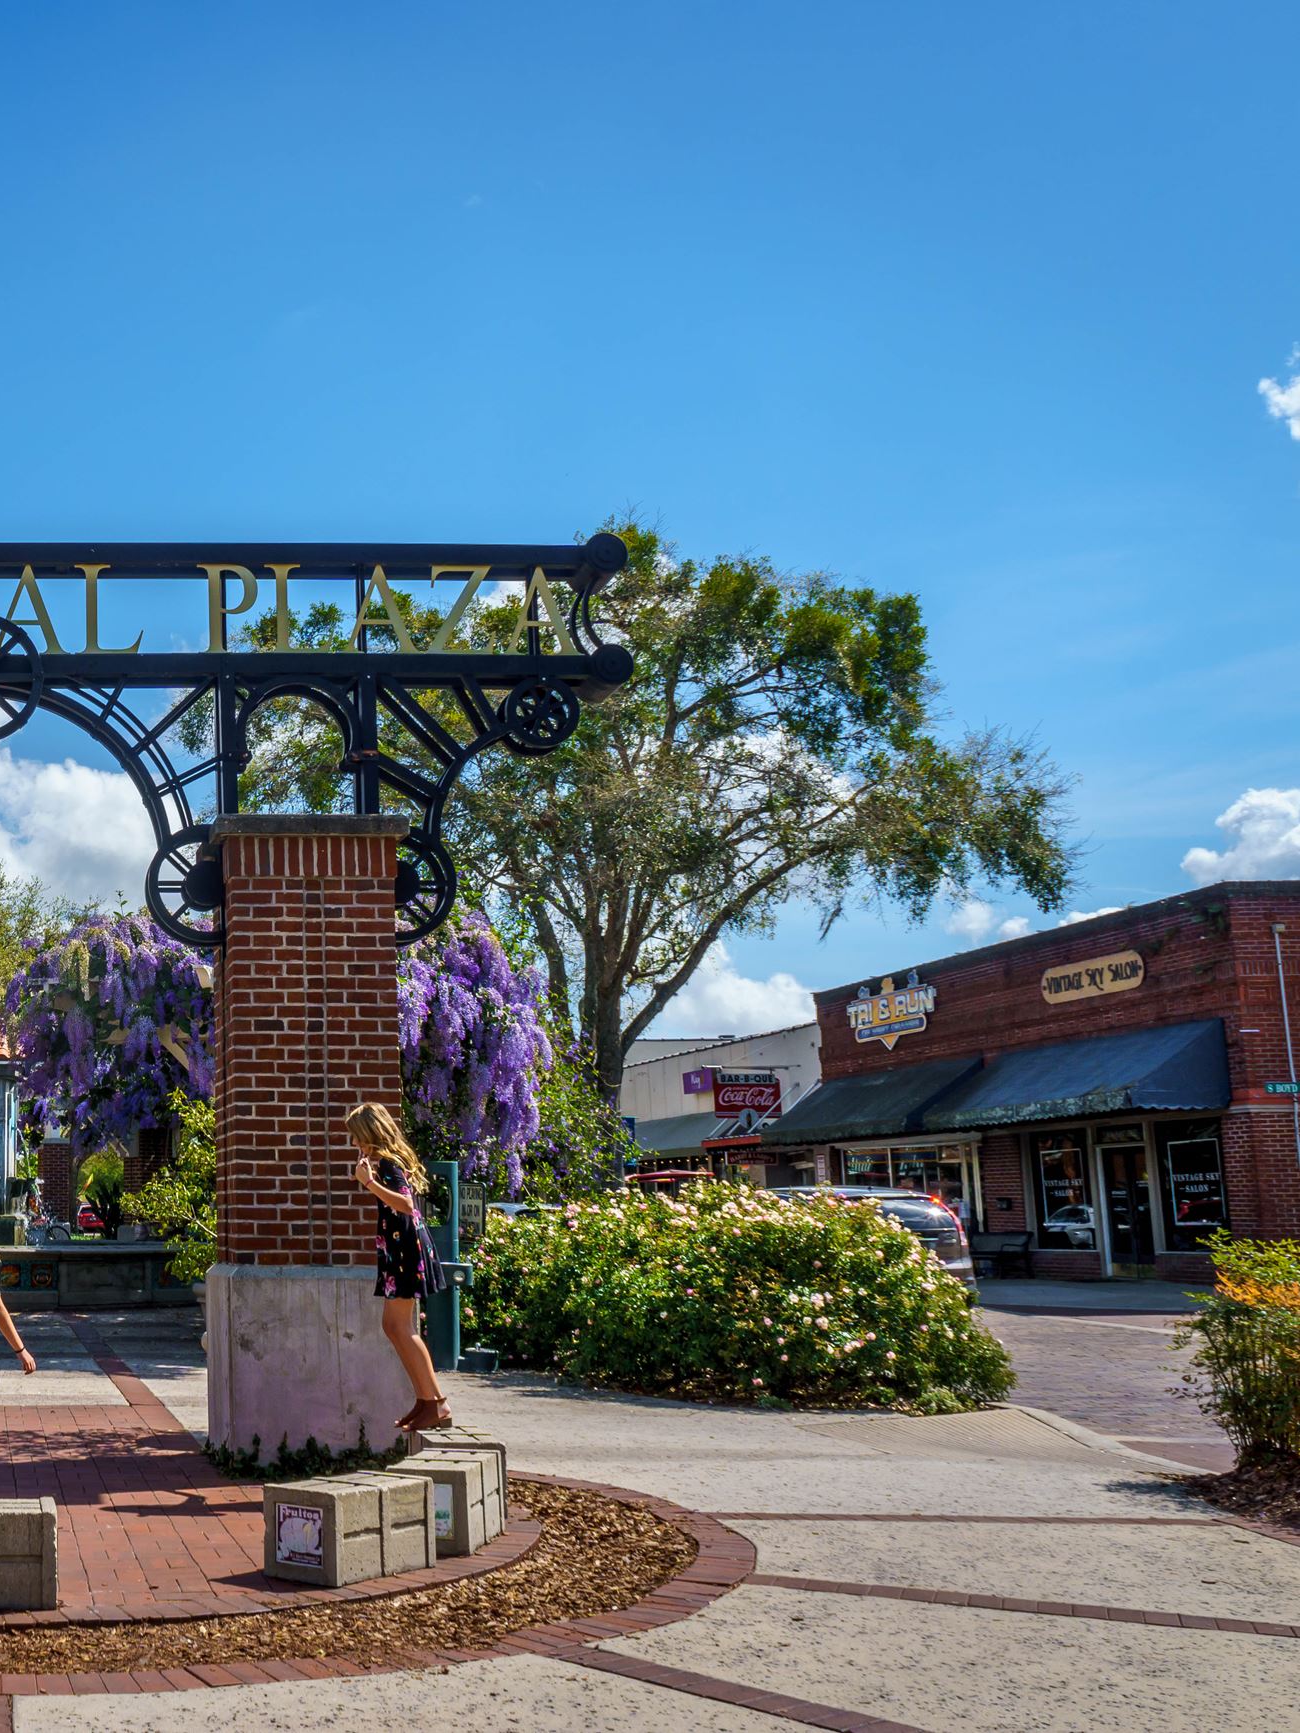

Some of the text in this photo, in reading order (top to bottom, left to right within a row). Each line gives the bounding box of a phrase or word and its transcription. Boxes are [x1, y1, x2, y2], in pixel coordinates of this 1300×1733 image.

[196, 564, 588, 657] PLAZA
[1046, 960, 1139, 994] VINTAGE SKY SALON
[847, 986, 935, 1028] TRI & RUN
[720, 1074, 774, 1083] BAR-B-QUE
[1267, 1083, 1298, 1093] S BOYD
[1054, 1189, 1074, 1197] SALON
[1185, 1184, 1209, 1192] SALON
